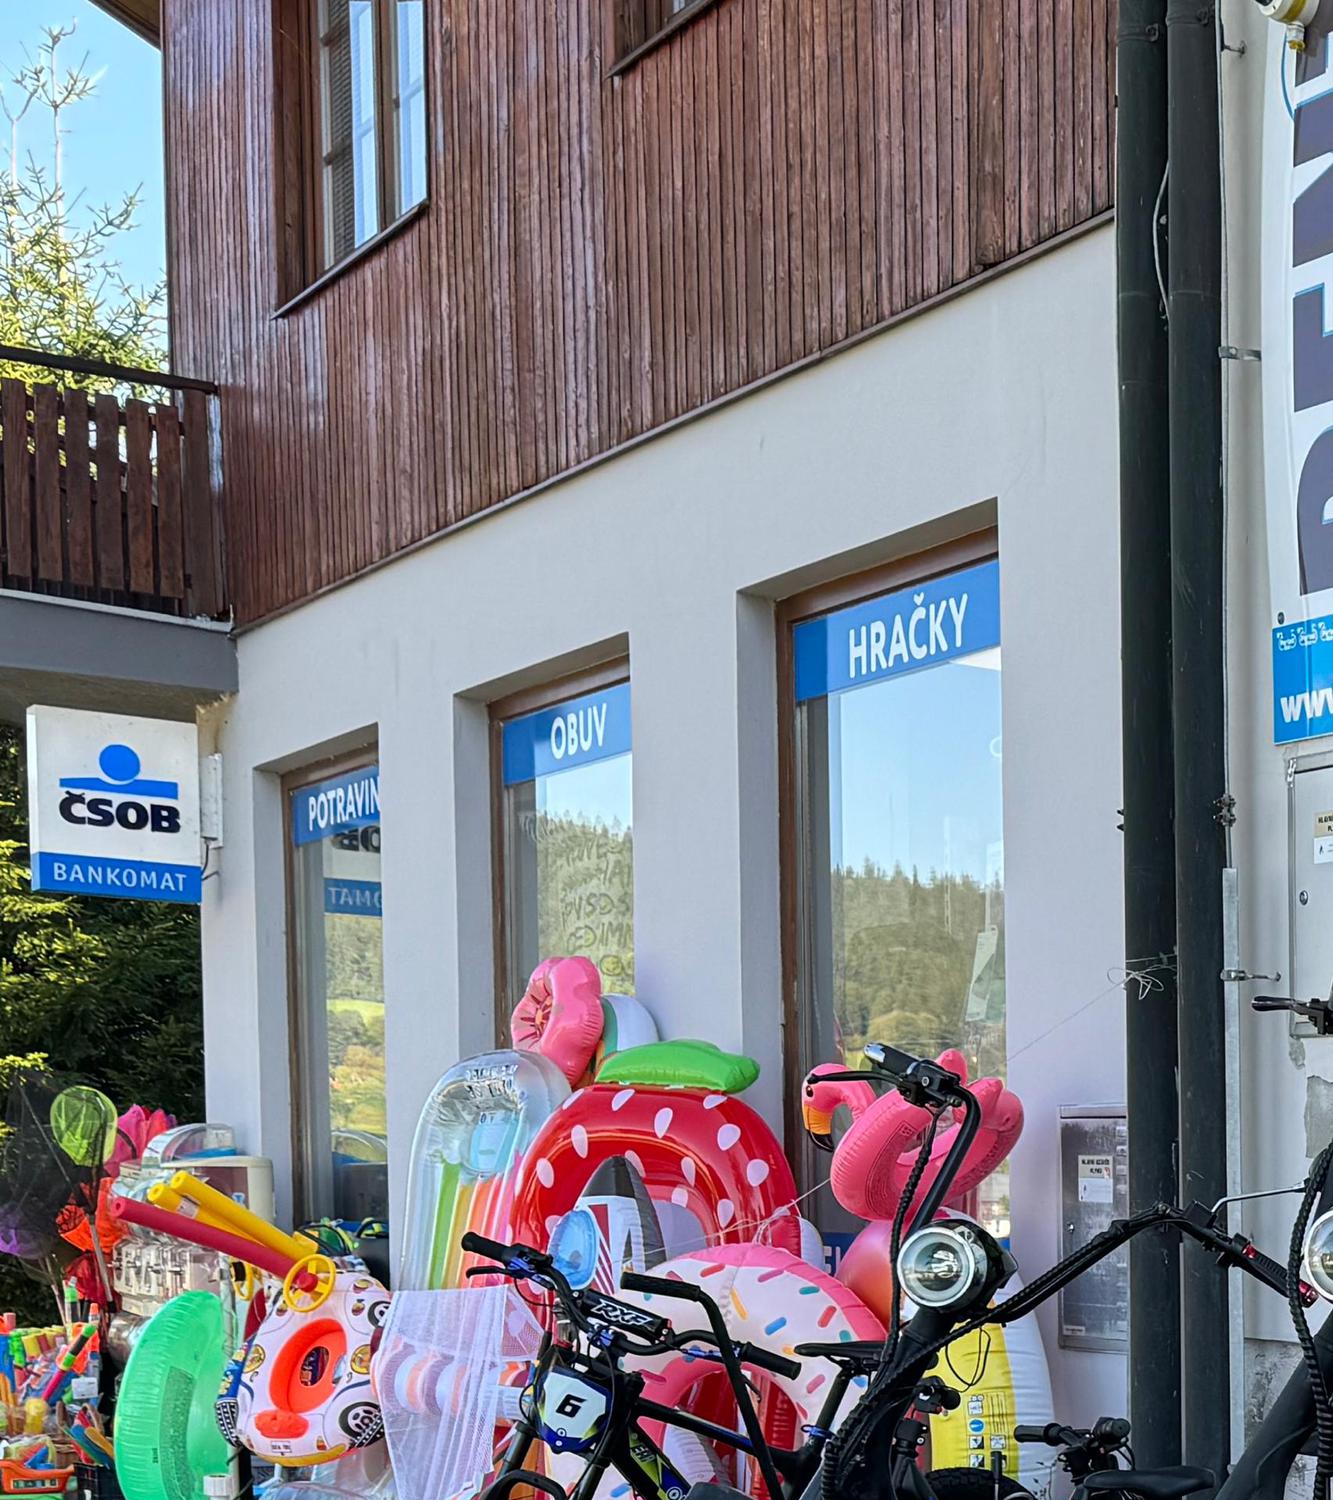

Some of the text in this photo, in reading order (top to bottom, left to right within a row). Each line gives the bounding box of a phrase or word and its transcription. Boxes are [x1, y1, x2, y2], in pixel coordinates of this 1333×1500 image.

[848, 591, 969, 678] HRAČKY
[550, 703, 607, 760] OBUV
[59, 790, 181, 833] ČSOB
[53, 862, 188, 892] BANKOMAT
[555, 1393, 588, 1419] 6
